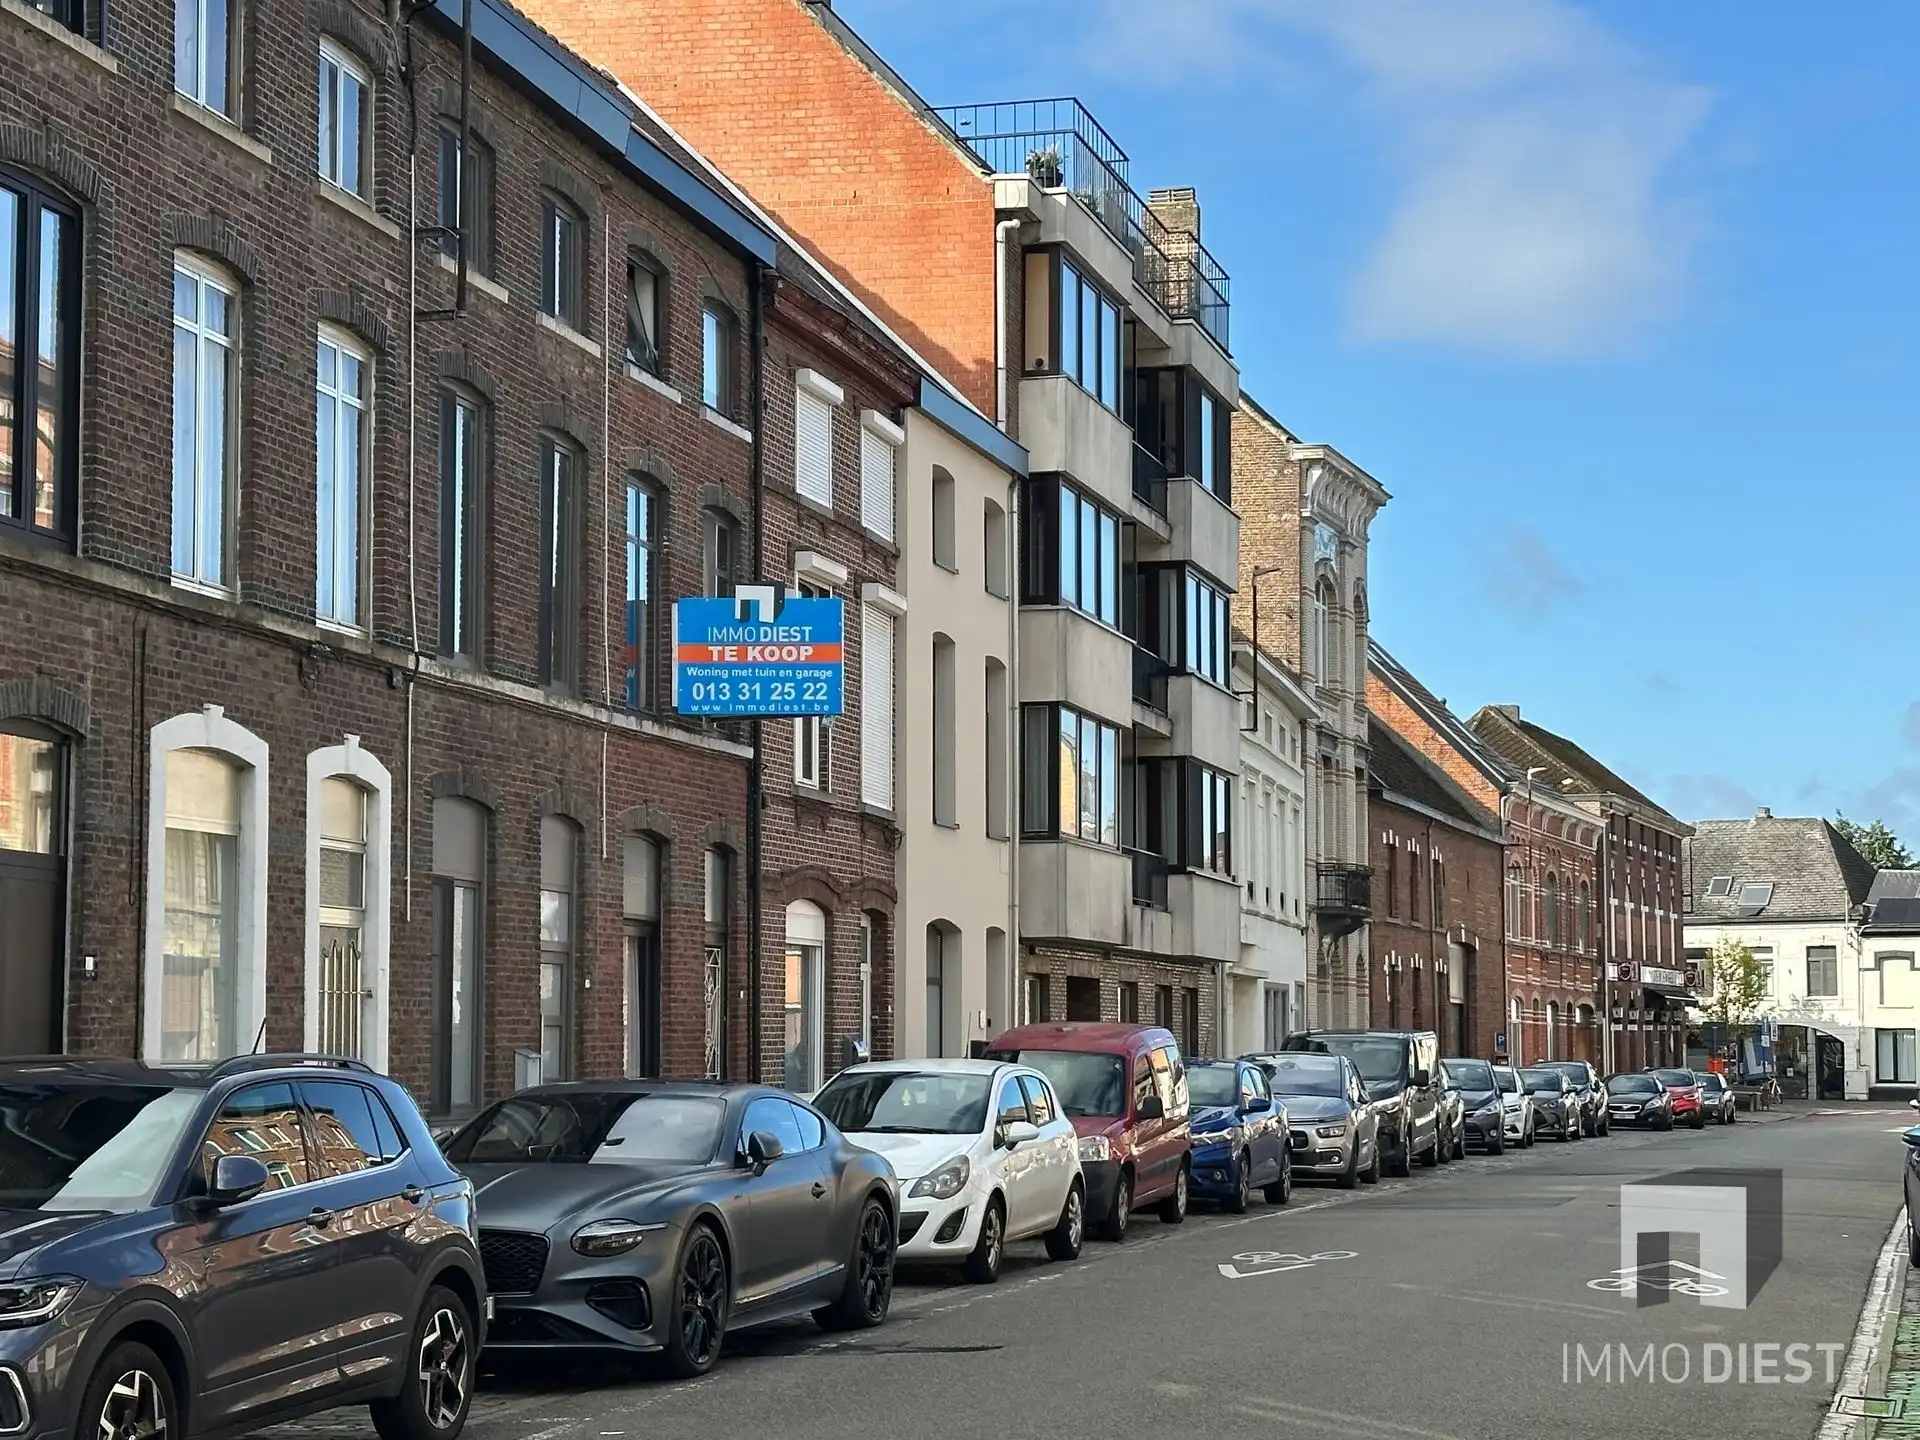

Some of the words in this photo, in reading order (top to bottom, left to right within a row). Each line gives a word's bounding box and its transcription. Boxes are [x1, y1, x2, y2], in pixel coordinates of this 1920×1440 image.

[708, 627, 756, 642] IMMO
[760, 626, 812, 642] DIEST
[708, 646, 738, 661] TE
[747, 646, 813, 661] KOOP
[687, 667, 728, 678] Woning
[731, 668, 752, 677] met
[755, 667, 776, 677] tuin
[779, 669, 792, 677] en
[795, 669, 833, 679] garage
[692, 682, 730, 700] 013
[738, 682, 761, 700] 31
[770, 682, 796, 700] 25
[803, 682, 828, 700] 22
[691, 703, 830, 712] www.immodiest.be
